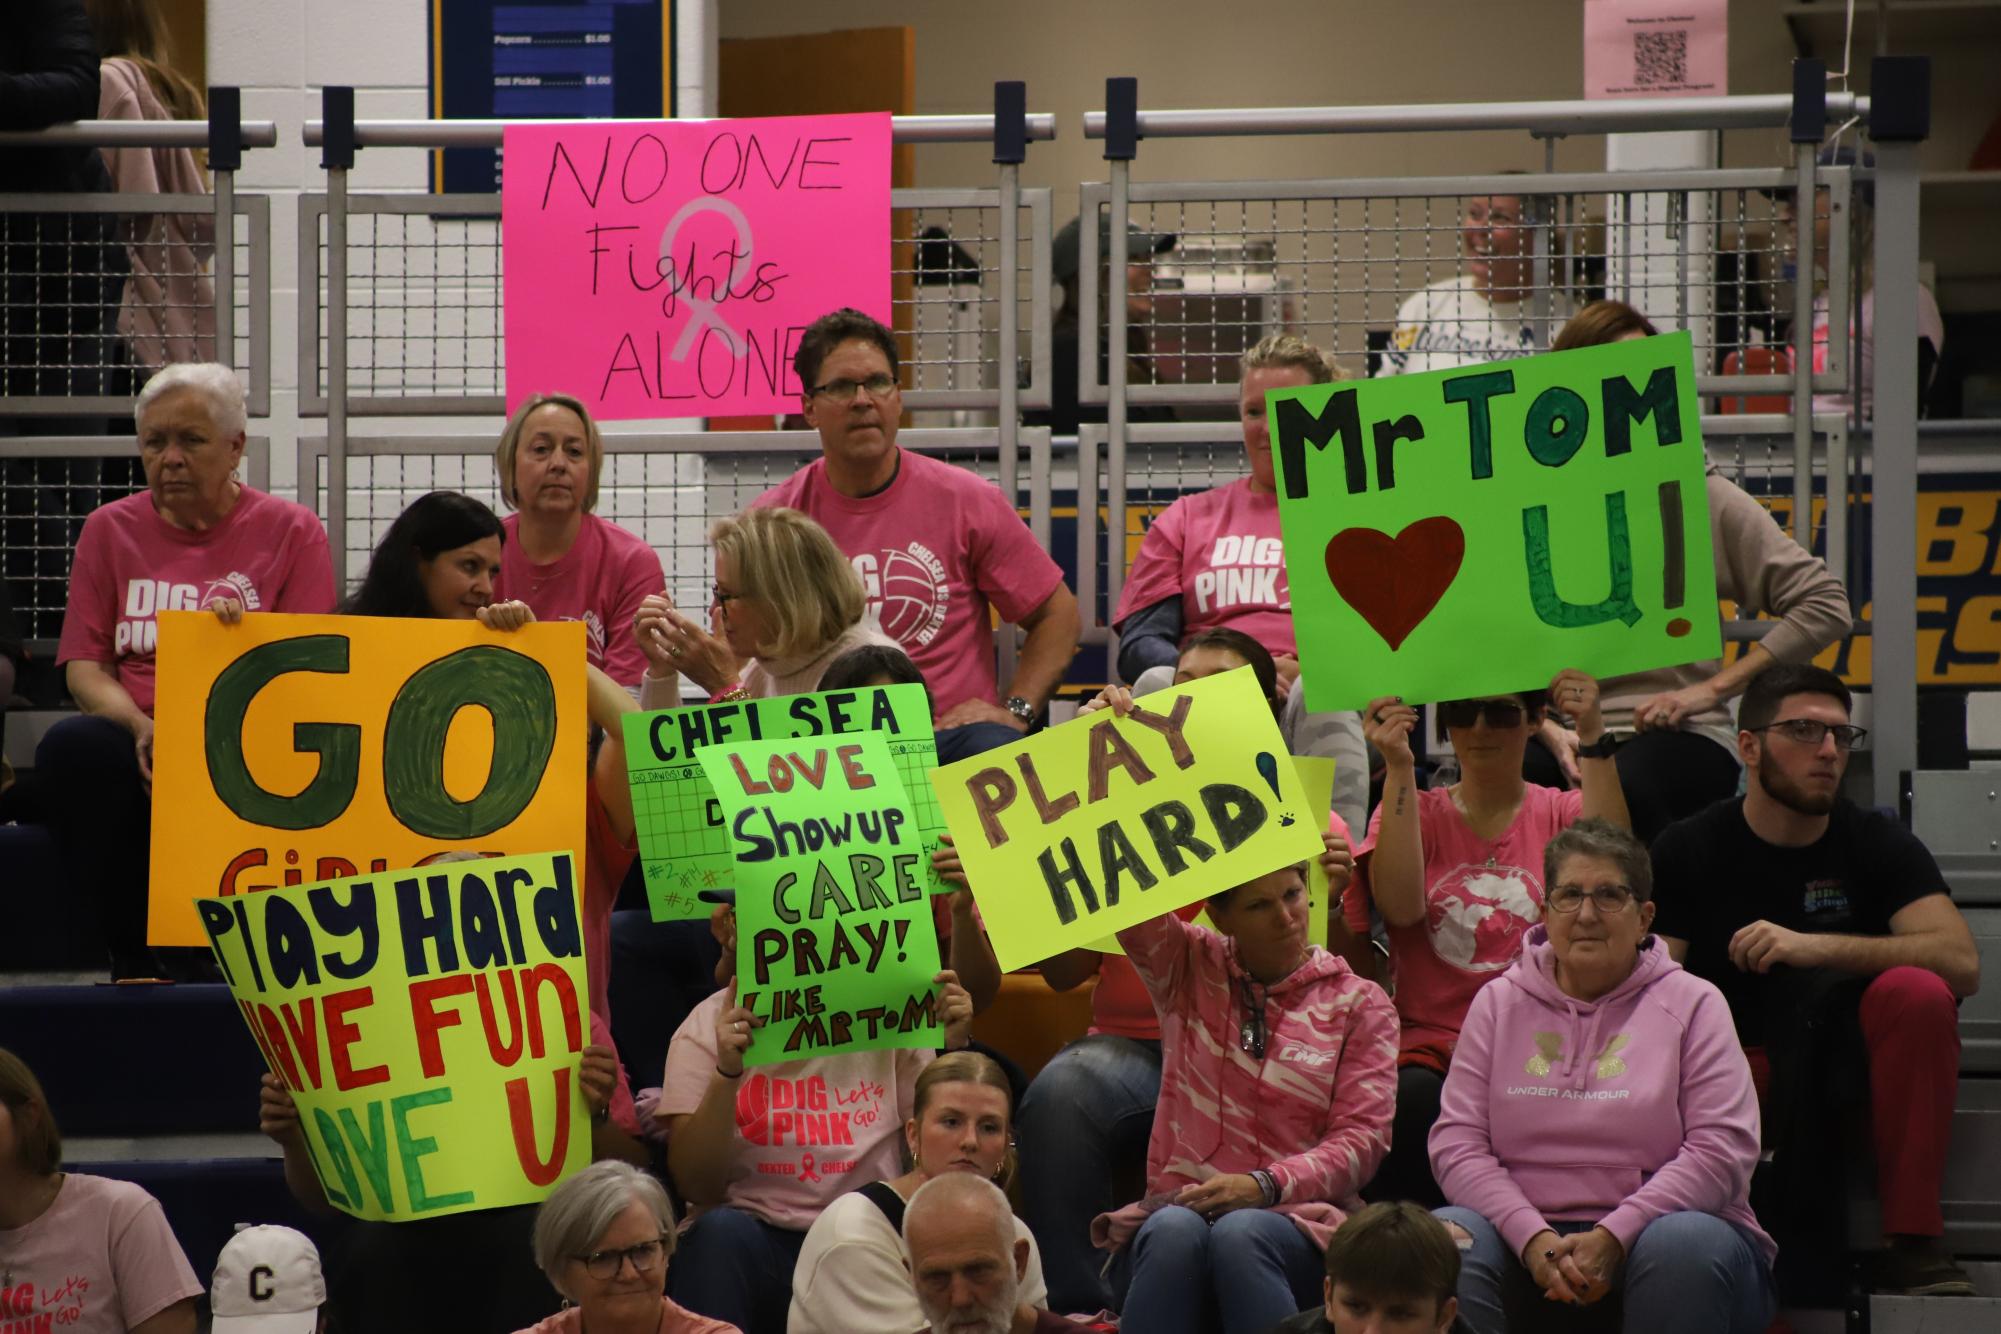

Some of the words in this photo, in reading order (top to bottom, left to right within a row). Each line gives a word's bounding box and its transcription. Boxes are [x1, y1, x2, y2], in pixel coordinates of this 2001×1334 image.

[542, 133, 669, 210] NO
[700, 132, 852, 195] ONE
[586, 222, 789, 319] Fights
[600, 326, 807, 401] ALONE
[1275, 388, 1425, 499] Mr
[1210, 535, 1283, 568] DIG
[125, 579, 199, 617] DIG
[1195, 567, 1280, 614] PINK
[204, 634, 558, 840] GO
[727, 744, 877, 796] LOVE
[965, 694, 1196, 850] PLAY
[773, 853, 922, 925] CARE
[753, 918, 912, 986] PRAY!
[742, 984, 827, 1029] LIKE
[783, 1010, 854, 1054] MR
[771, 1074, 829, 1112] DIG
[1506, 1085, 1559, 1098] UNDER
[1561, 1088, 1630, 1101] ARMOUR
[504, 1066, 572, 1187] U
[771, 1111, 855, 1147] PINK
[250, 1266, 275, 1301] C
